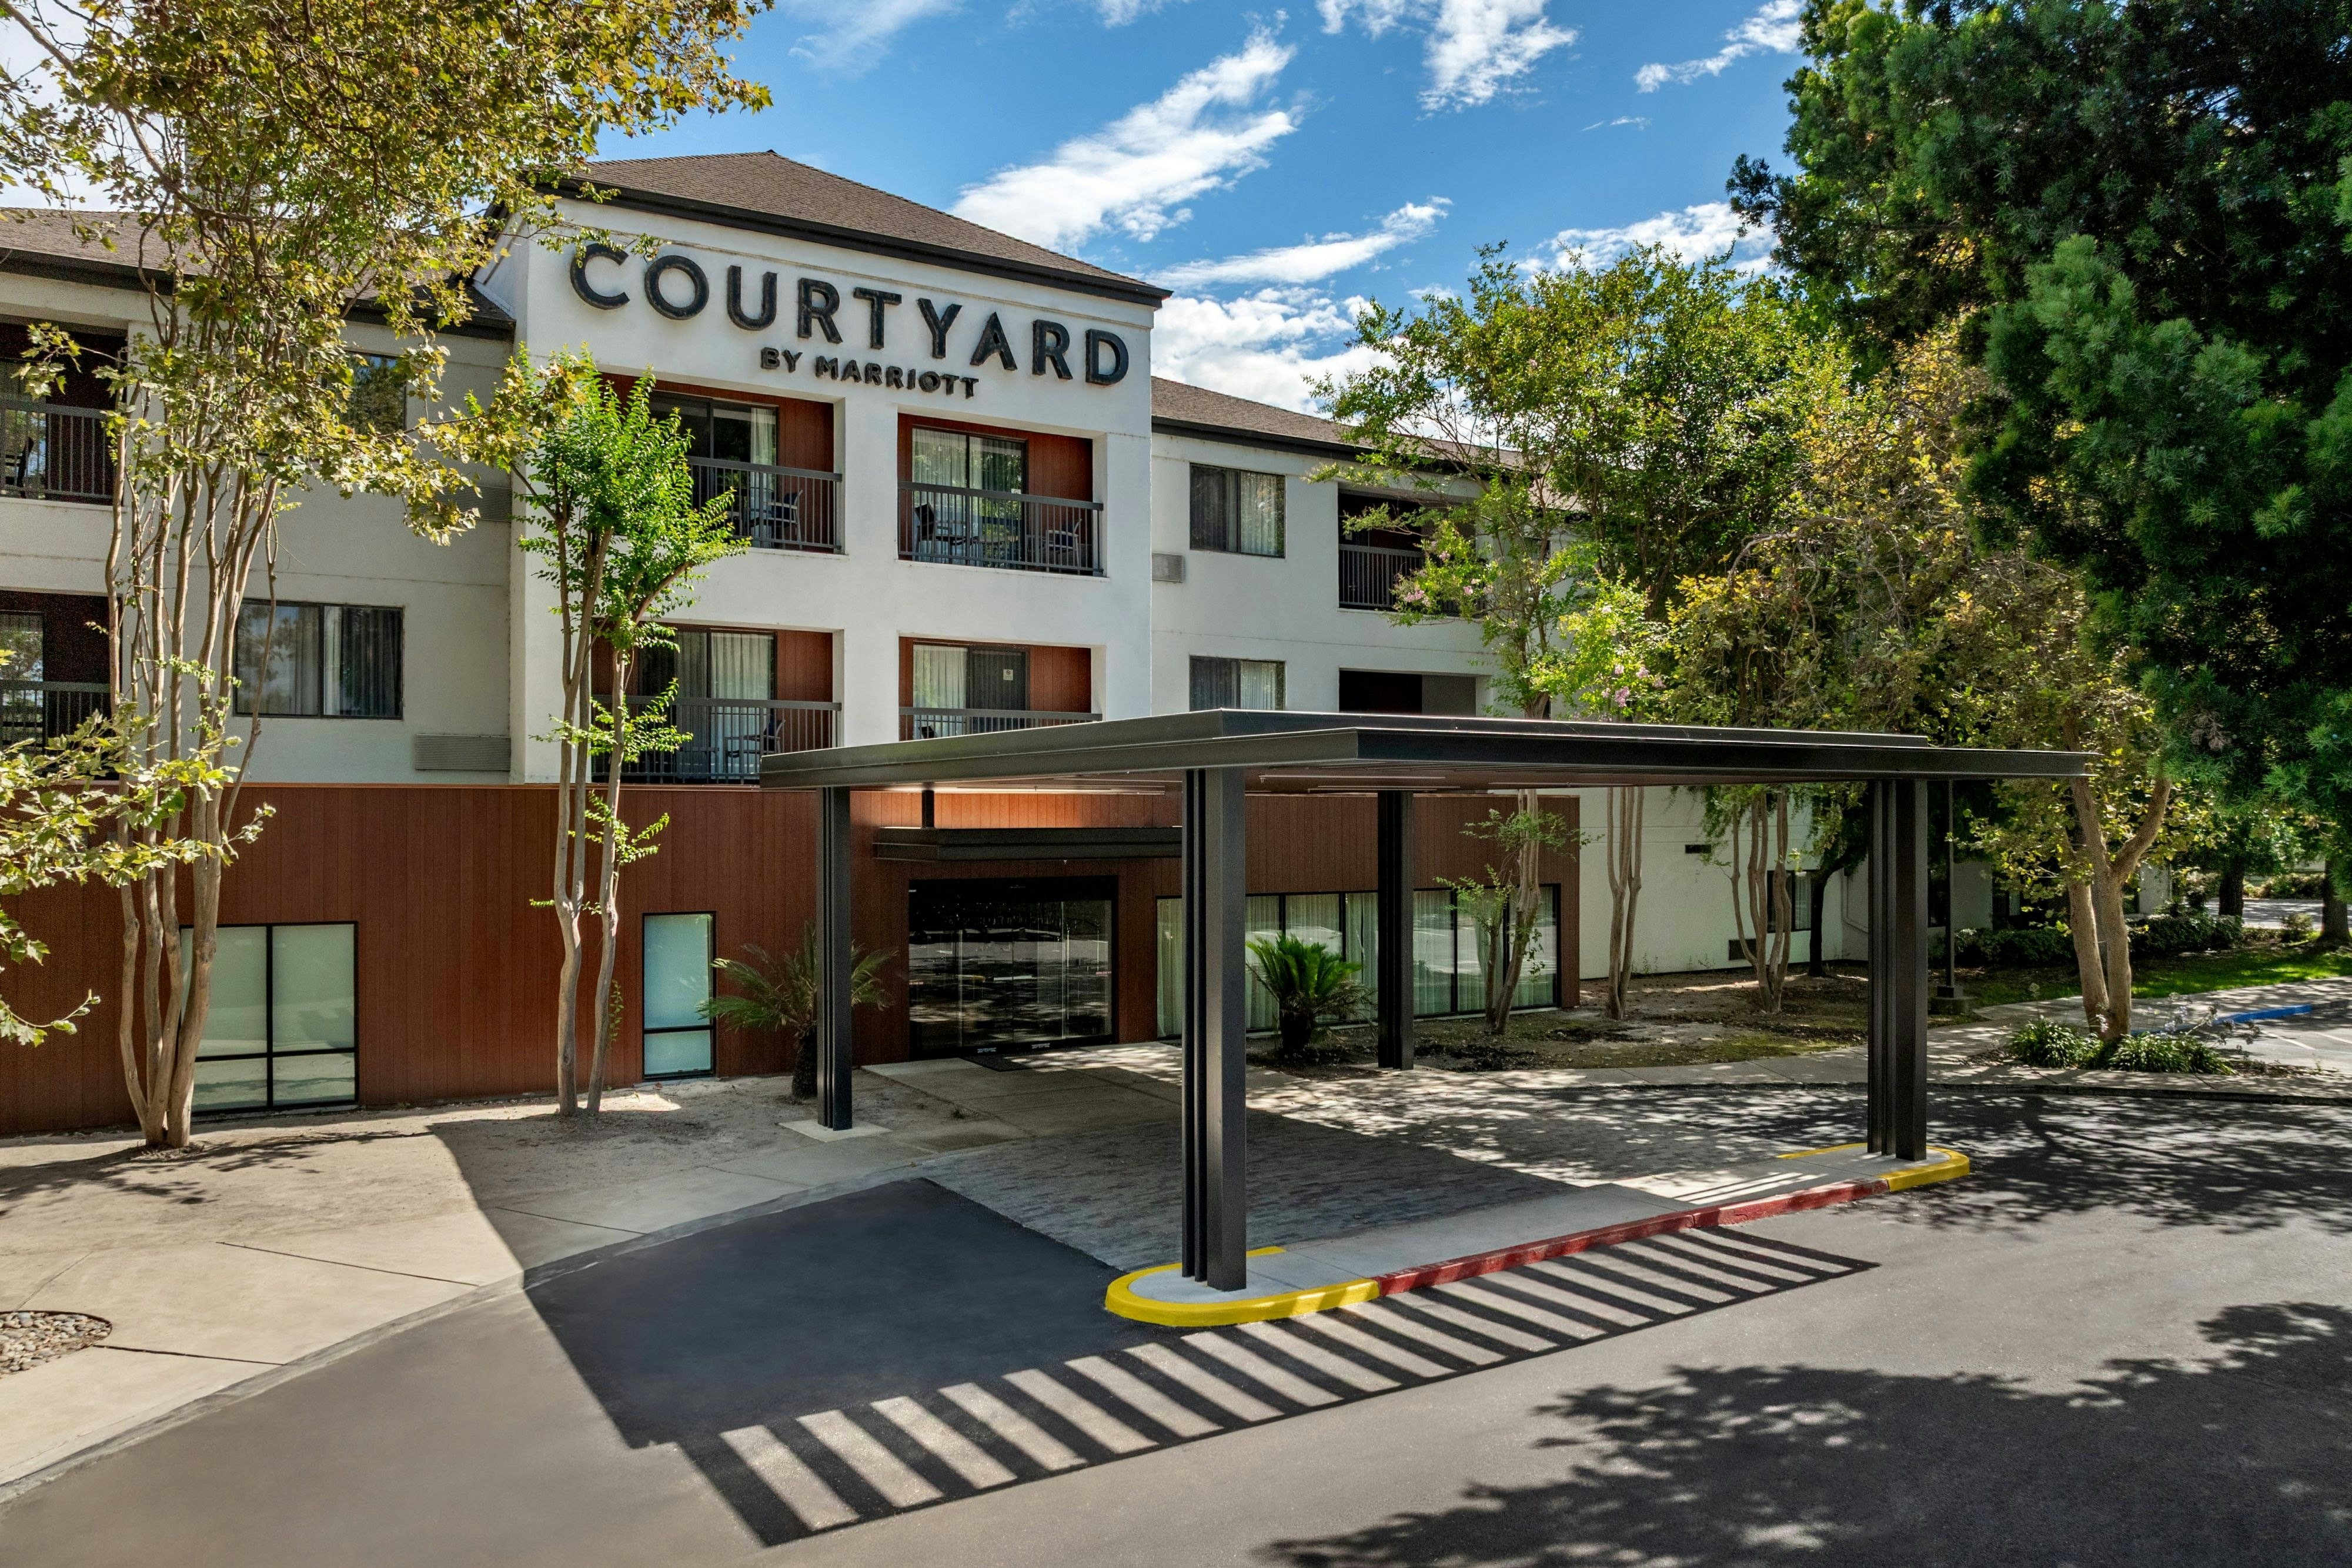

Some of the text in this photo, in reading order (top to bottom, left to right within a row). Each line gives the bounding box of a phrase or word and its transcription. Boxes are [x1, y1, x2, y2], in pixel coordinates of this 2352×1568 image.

[570, 243, 1129, 386] COURTYARD
[761, 347, 979, 399] BY MARRIOTT
